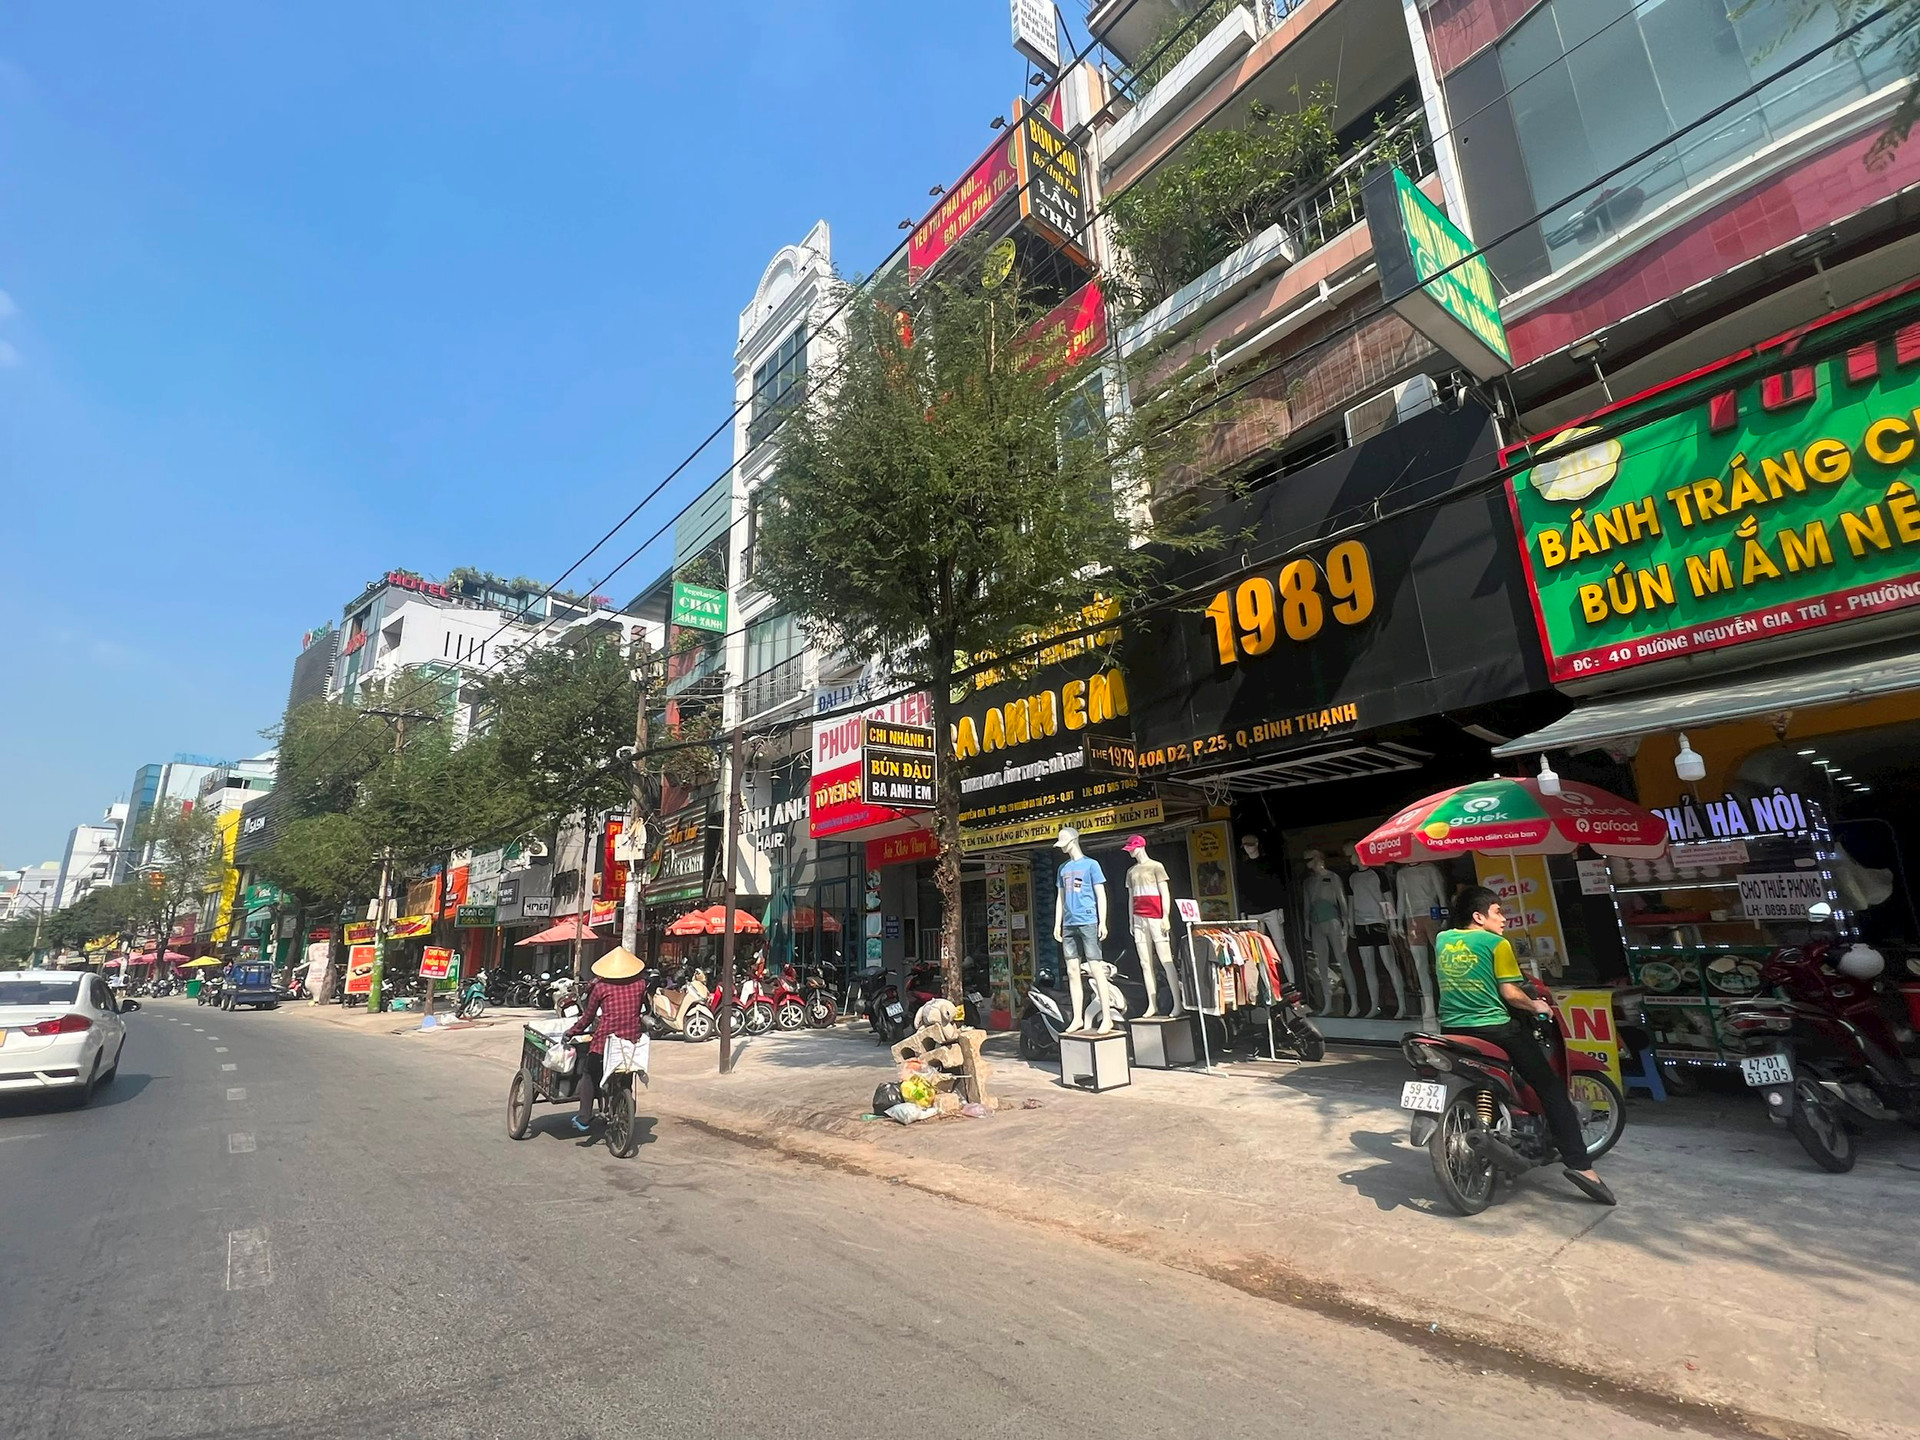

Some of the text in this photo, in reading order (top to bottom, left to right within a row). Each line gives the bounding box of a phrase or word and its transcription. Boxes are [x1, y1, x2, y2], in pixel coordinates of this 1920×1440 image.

[1537, 406, 1920, 569] BÁNH TRÁNG C
[1577, 560, 1676, 625] BÚN
[1684, 513, 1835, 598] MẮM
[388, 572, 451, 599] HOTEL
[1205, 540, 1375, 666] 1989
[1607, 646, 1633, 664] 40
[1637, 628, 1690, 658] ĐƯỜNG
[1692, 615, 1758, 645] NGUYỄN
[1762, 610, 1794, 629] GIA
[1796, 599, 1828, 621] TRÍ
[981, 689, 1059, 753] ANH
[1062, 667, 1131, 733] EM
[869, 726, 932, 749] CHI NHÁNH 1
[1138, 750, 1166, 769] 40A
[1295, 702, 1359, 732] THẠNH
[1090, 745, 1136, 769] THE 1979
[870, 755, 932, 784] BÚN ĐẬU
[872, 781, 932, 801] BA ANH EM
[1143, 804, 1159, 820] PHÍ
[1449, 812, 1509, 828] gojek
[1705, 793, 1750, 837] HÀ
[1750, 787, 1808, 838] NỘI
[1593, 820, 1639, 834] gofood
[756, 832, 786, 852] HAIR
[1376, 836, 1401, 854] gofood
[1740, 876, 1822, 900] CHO THUÊ PHÒNG
[1745, 905, 1763, 917] LH:
[1748, 1069, 1789, 1084] 533.05
[1409, 1082, 1440, 1098] 59-S2
[1403, 1095, 1441, 1111] 872.44
